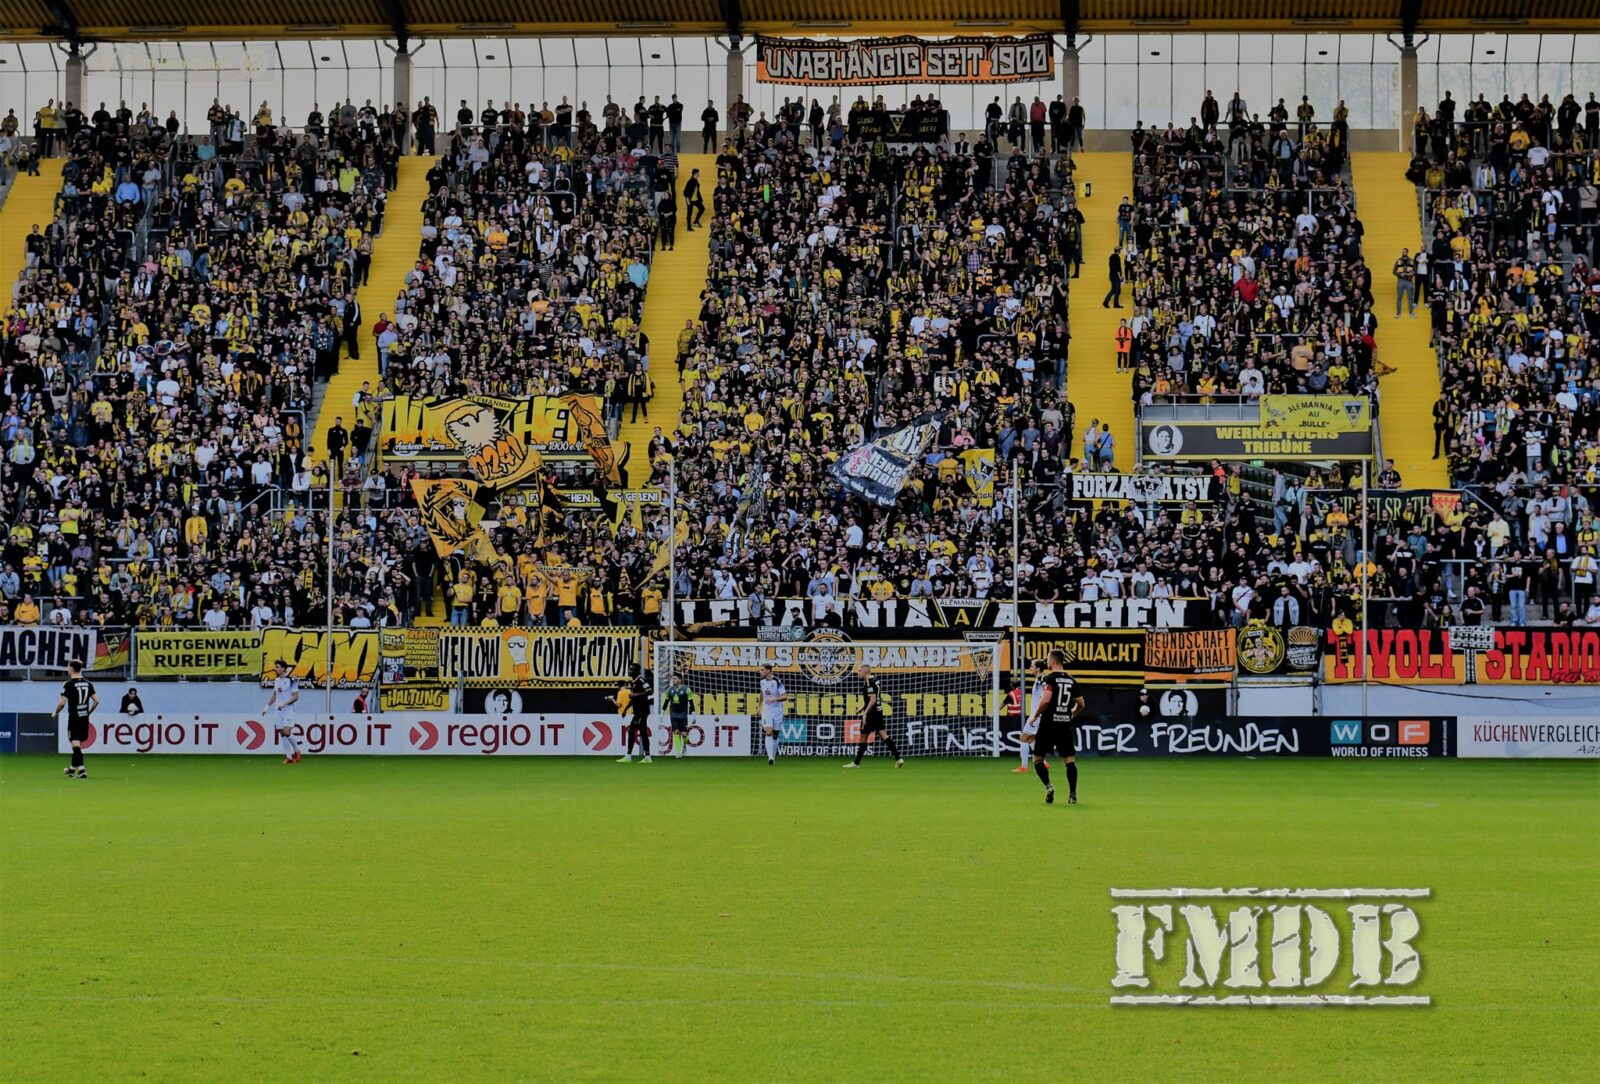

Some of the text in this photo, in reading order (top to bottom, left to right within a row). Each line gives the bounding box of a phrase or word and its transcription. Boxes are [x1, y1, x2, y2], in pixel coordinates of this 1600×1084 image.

[765, 43, 1049, 78] UNABHÄNGIG SEIT 1900
[1288, 402, 1333, 414] ALEMANNIA
[1242, 440, 1312, 454] TRIBÜNE
[1072, 475, 1211, 501] FORZA ATSV
[940, 599, 983, 607] ALEMANNIA
[993, 602, 1186, 628] AACHEN
[0, 630, 89, 668] ACHEN
[140, 638, 261, 651] HÜRTGENWALD
[440, 636, 501, 677] YELLOW
[533, 637, 635, 677] CONNECTION
[692, 645, 962, 668] KARLS BANDE
[1326, 628, 1456, 680] TIVOLI
[154, 653, 248, 668] RUREIFEL
[76, 686, 89, 704] 17
[387, 689, 443, 707] HALTUNG
[1057, 683, 1072, 707] 15
[103, 716, 219, 754] regio iT
[366, 716, 392, 746] iT
[447, 716, 565, 754] regio iT
[714, 717, 739, 747] iT
[907, 720, 1022, 752] FITNESS
[1151, 722, 1299, 753] FREUNDEN
[778, 746, 813, 756] WORLD
[816, 746, 828, 756] OF
[1331, 746, 1428, 757] WORLD OF FITNESS
